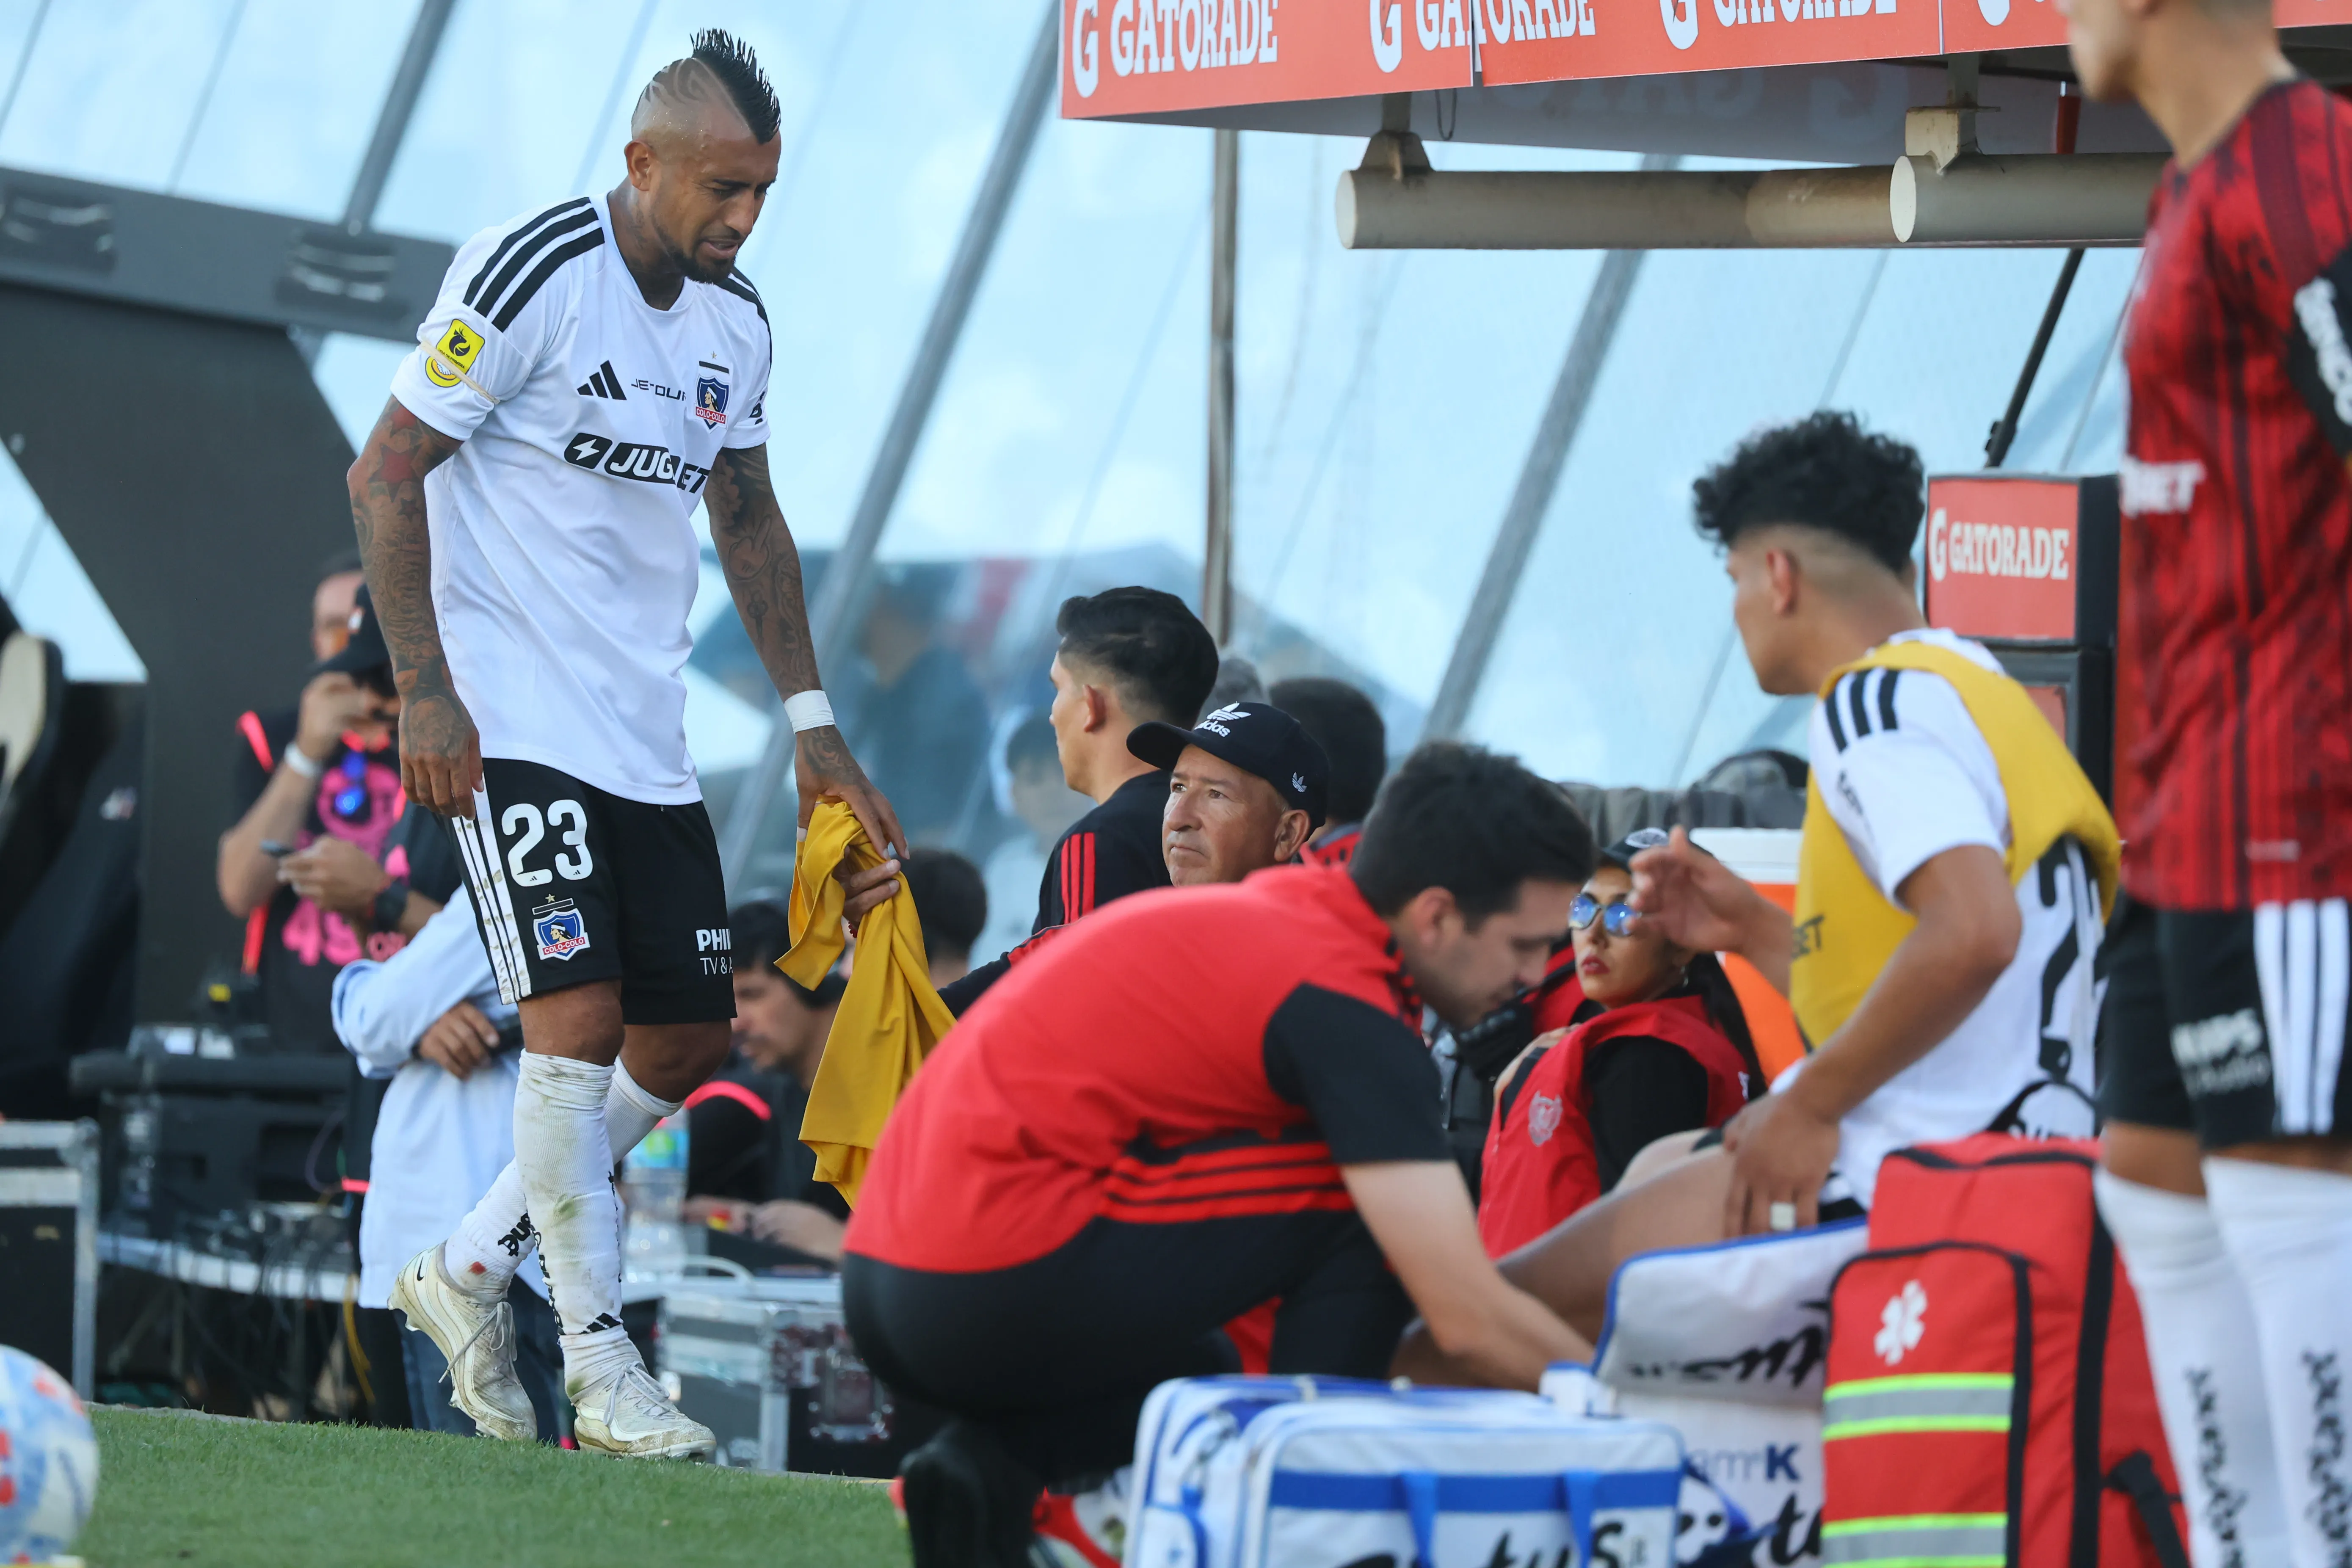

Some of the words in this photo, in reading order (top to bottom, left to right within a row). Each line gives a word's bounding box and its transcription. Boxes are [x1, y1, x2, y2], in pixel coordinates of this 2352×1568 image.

[1110, 0, 1278, 77] GATORADE
[696, 408, 725, 423] COLO-COLO
[1949, 521, 2069, 580] GATORADE
[502, 799, 593, 887] 23
[544, 938, 584, 954] COLO-COLO
[700, 957, 718, 975] TV
[721, 957, 727, 974] &
